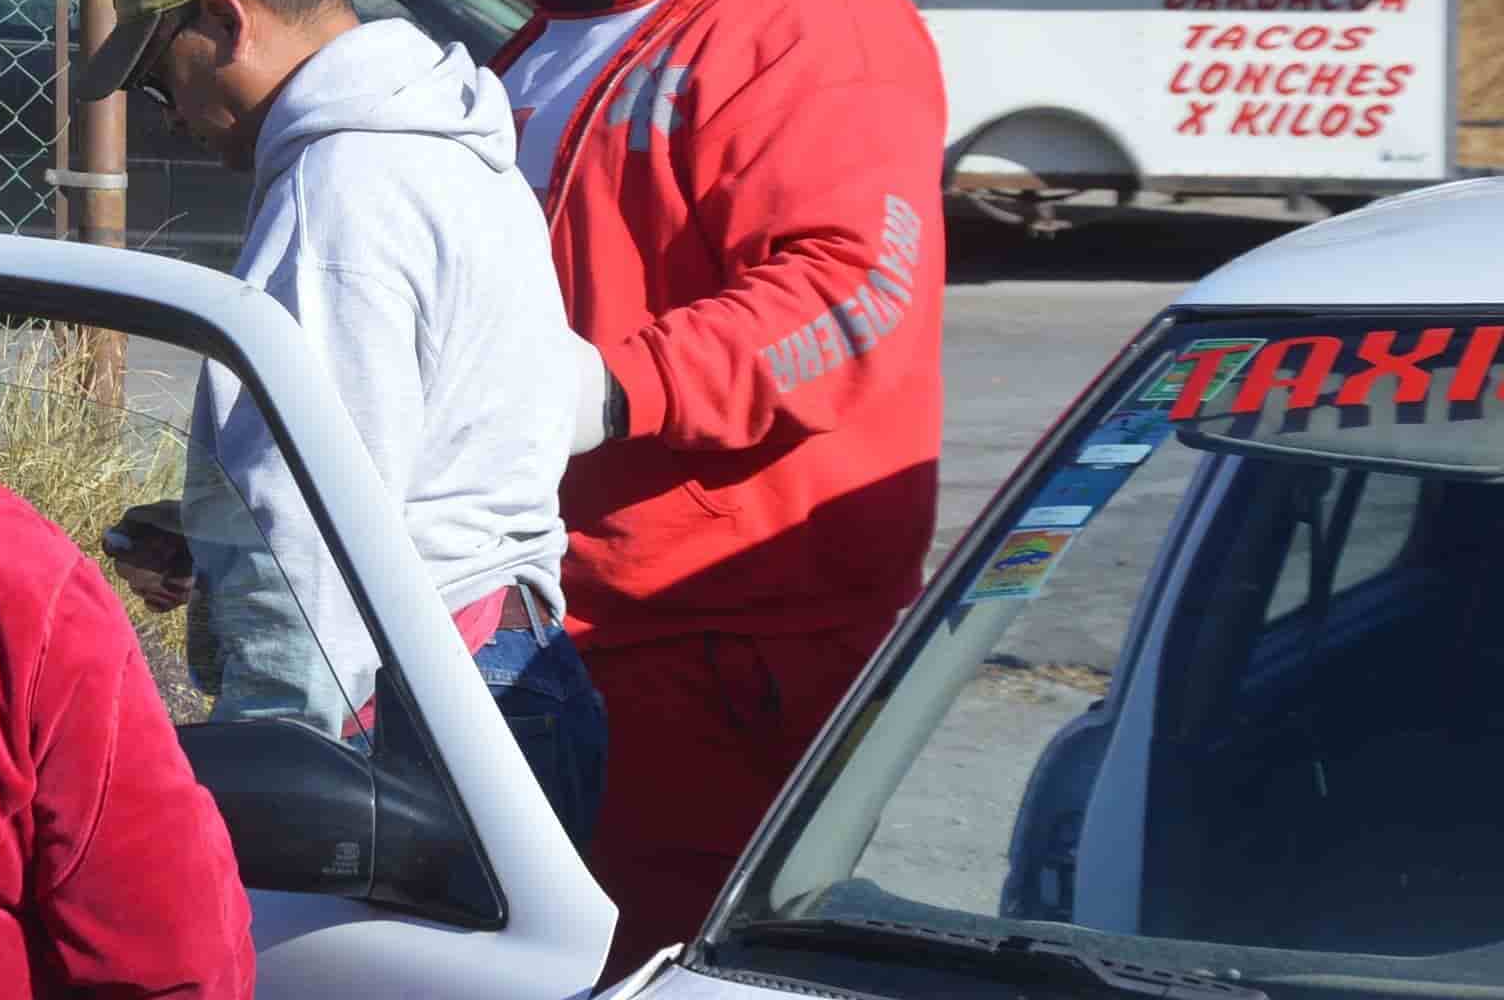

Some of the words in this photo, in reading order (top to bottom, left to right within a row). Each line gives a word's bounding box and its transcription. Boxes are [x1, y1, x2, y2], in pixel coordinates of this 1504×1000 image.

[1184, 24, 1376, 52] TACOS
[1168, 61, 1415, 98] LONCHES
[1176, 102, 1215, 136] X
[1229, 102, 1393, 138] KILOS
[1170, 326, 1504, 420] TAXI
